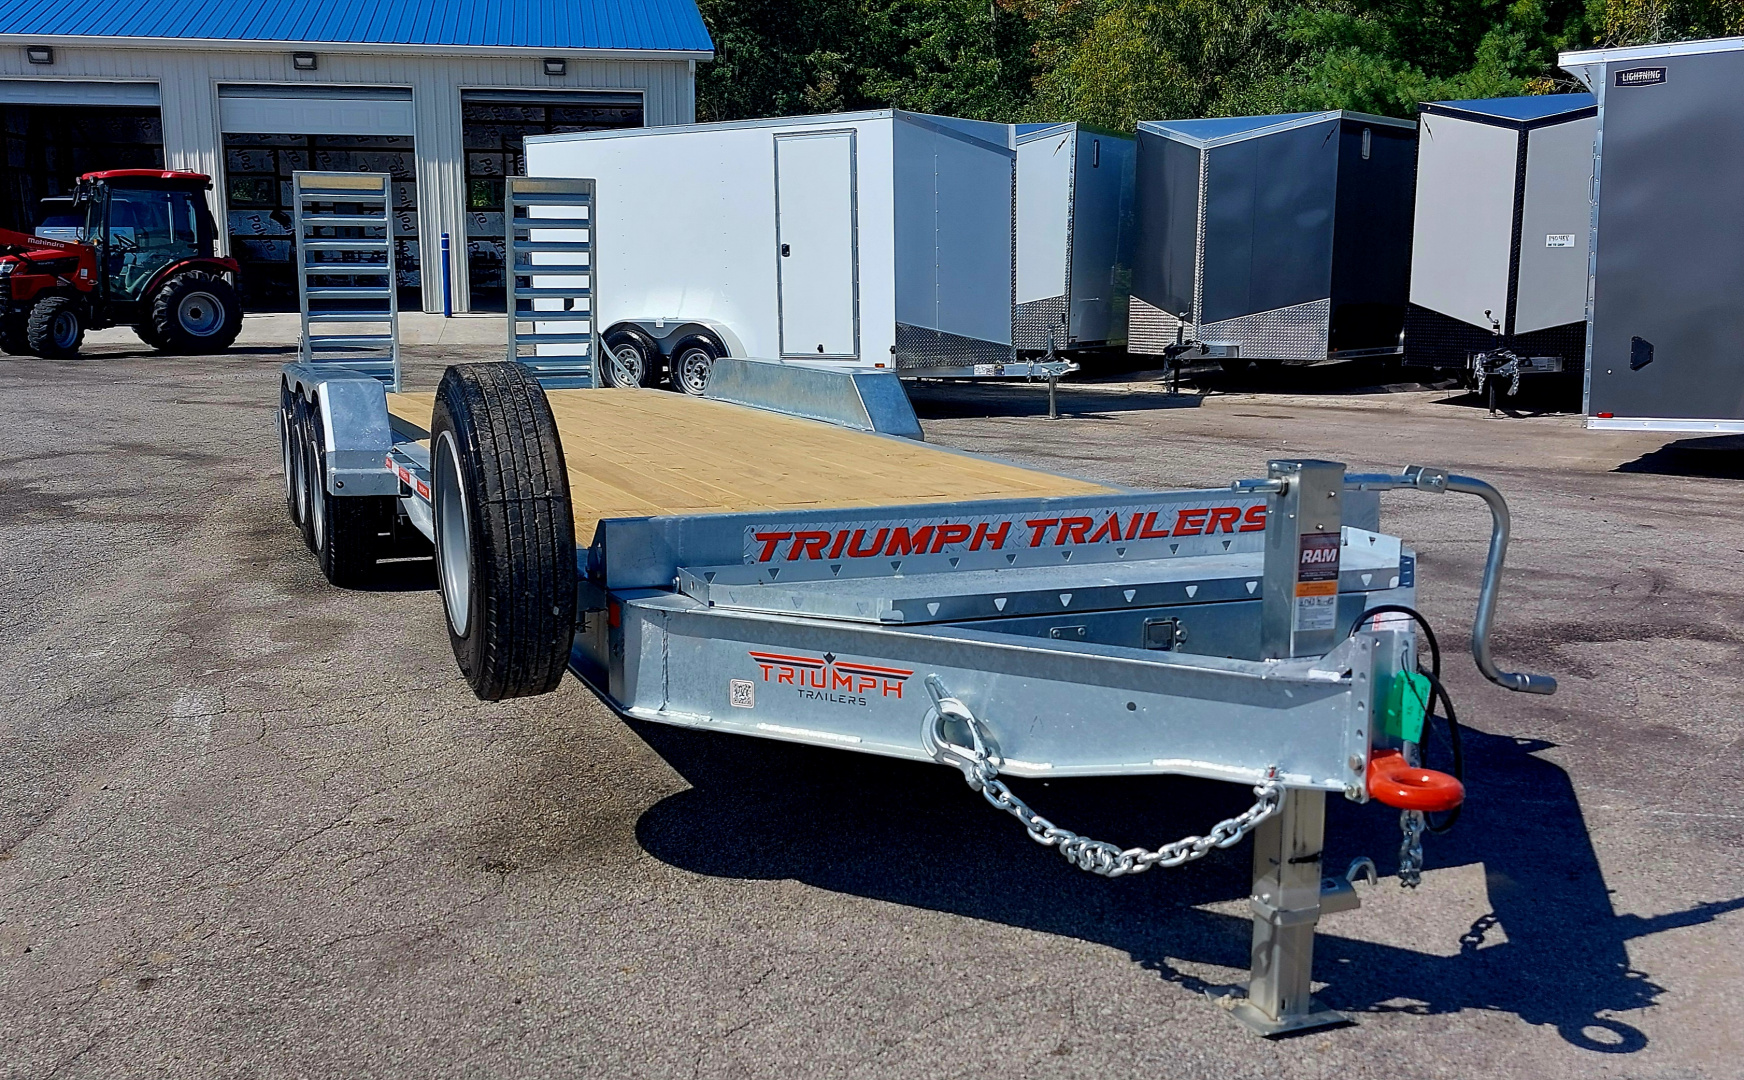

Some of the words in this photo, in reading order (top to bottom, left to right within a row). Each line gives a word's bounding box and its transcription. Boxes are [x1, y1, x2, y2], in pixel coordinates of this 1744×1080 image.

[1622, 70, 1661, 82] LIGHTNING
[755, 521, 1012, 563] TRIUMPH
[1026, 505, 1267, 548] TRAILERS
[1301, 548, 1338, 564] RAM
[759, 663, 904, 699] TRIUMPH
[797, 689, 867, 706] TRAILERS
